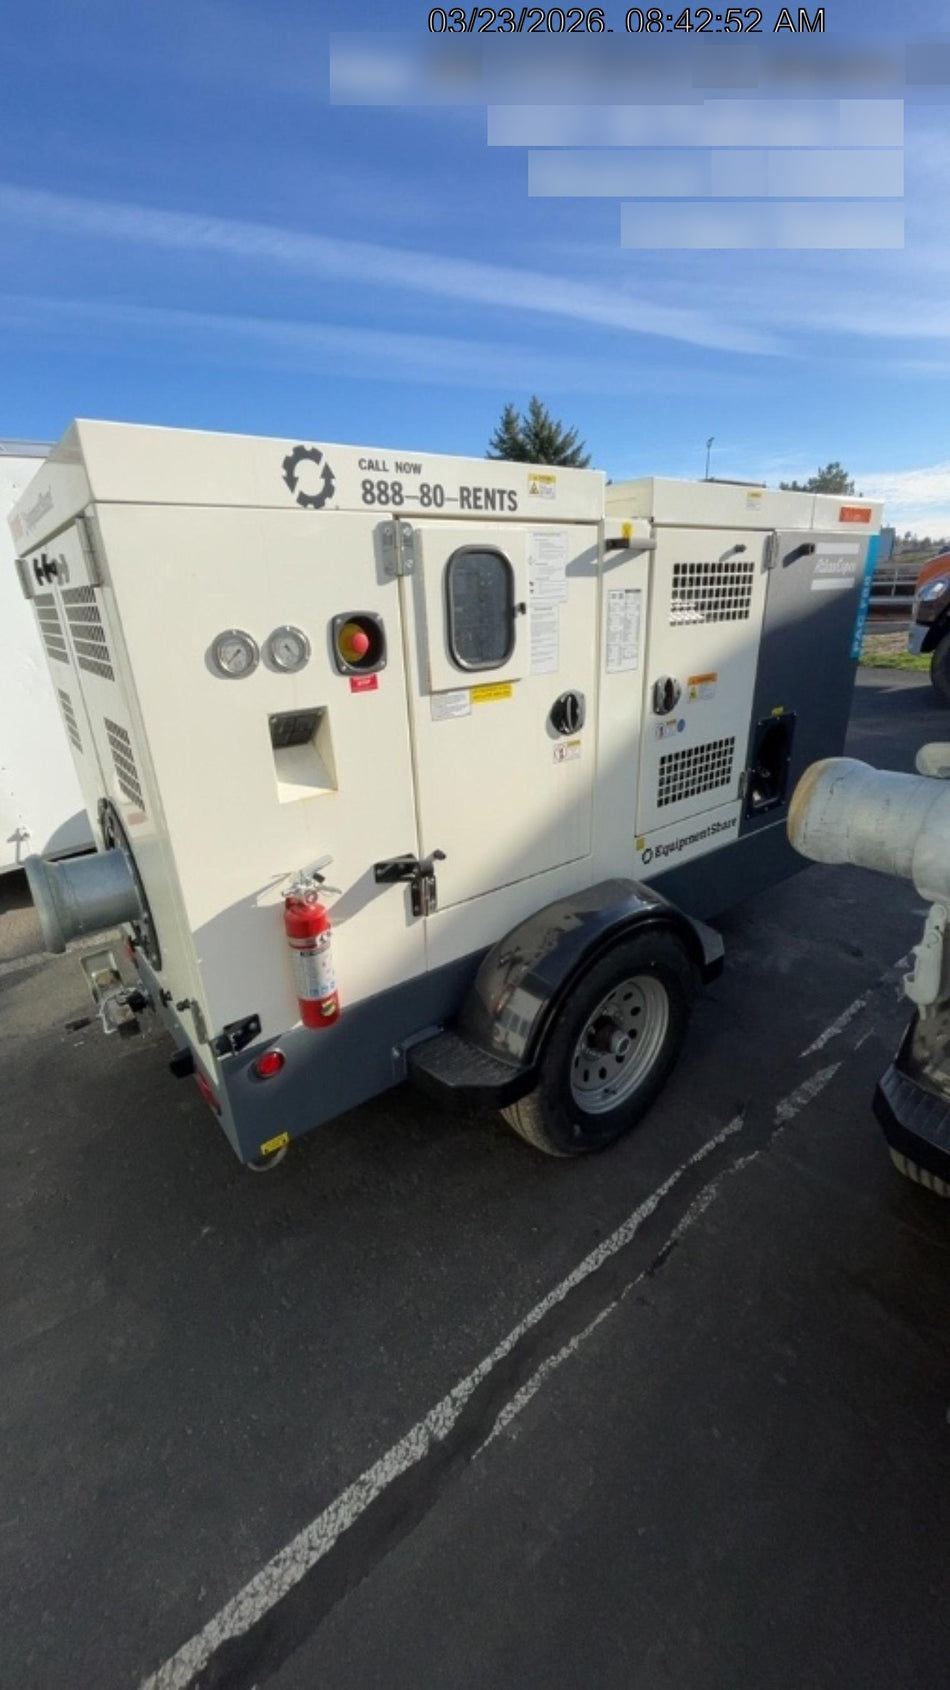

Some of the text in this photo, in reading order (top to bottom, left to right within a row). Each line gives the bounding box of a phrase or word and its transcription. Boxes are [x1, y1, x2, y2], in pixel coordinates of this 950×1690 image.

[358, 458, 422, 475] CALL NOW
[655, 817, 737, 858] EquipmentShare
